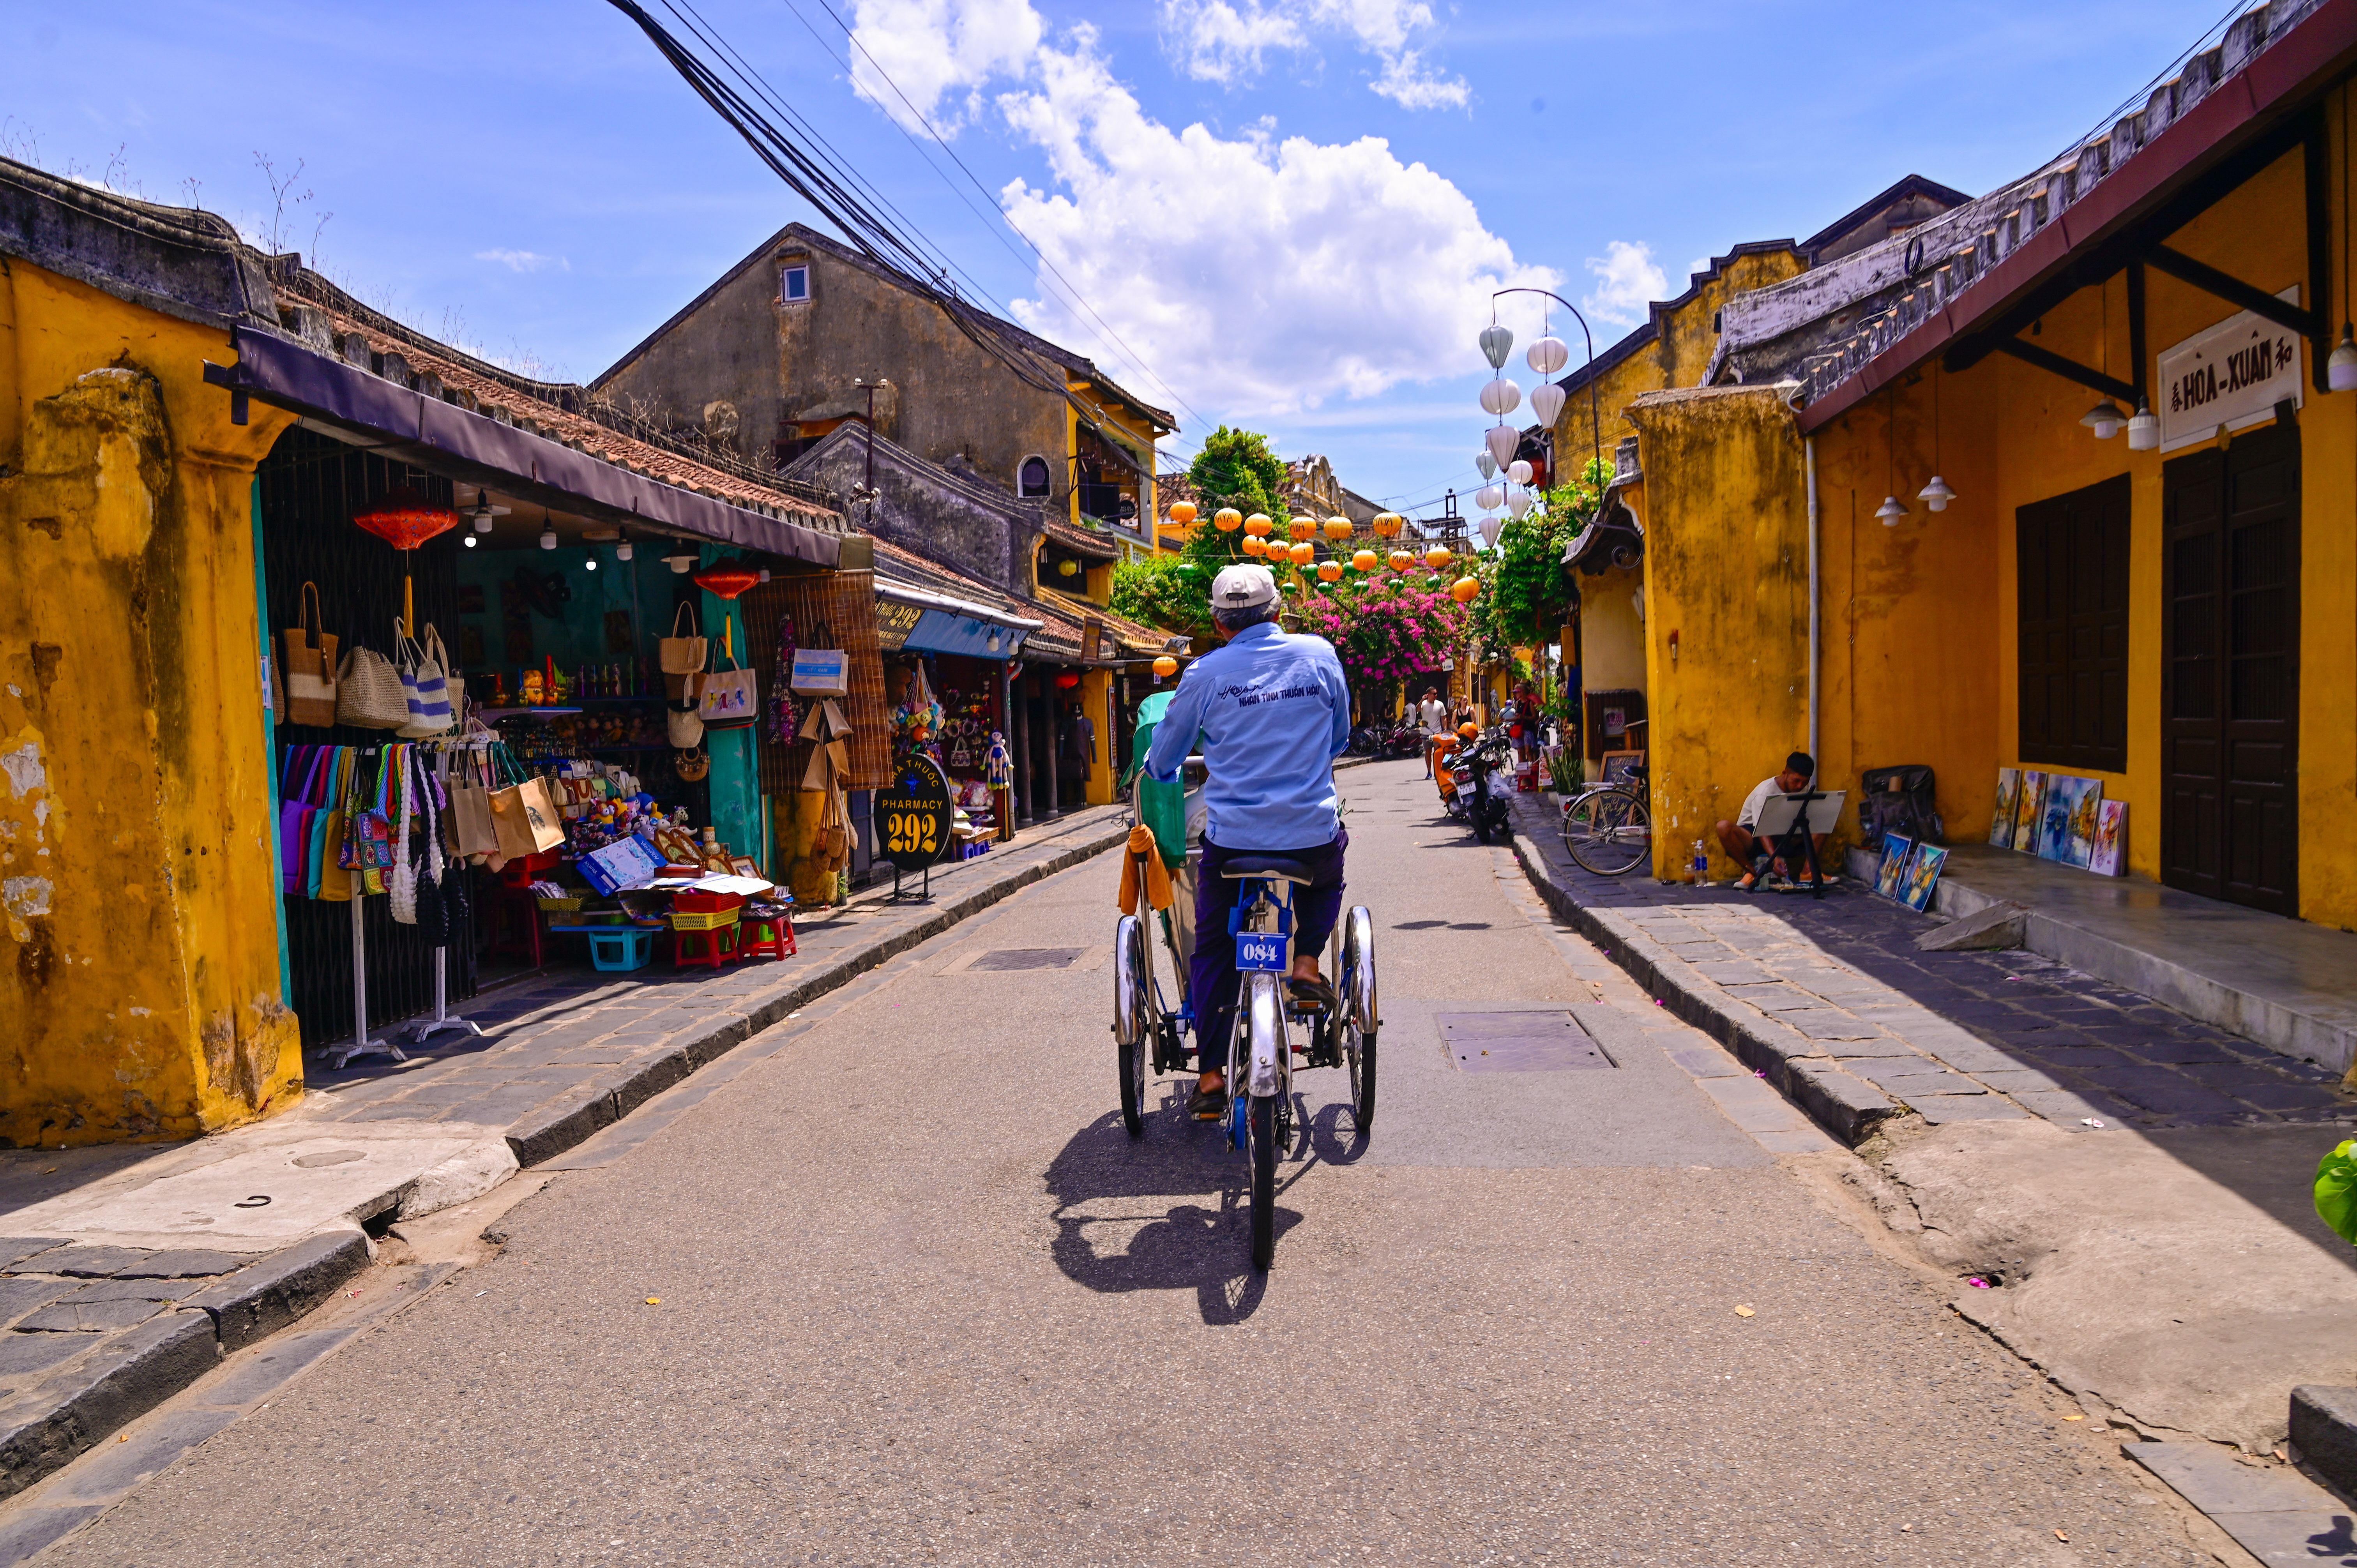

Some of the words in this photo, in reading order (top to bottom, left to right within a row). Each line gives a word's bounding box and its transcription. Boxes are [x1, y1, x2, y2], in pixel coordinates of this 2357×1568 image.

[2183, 330, 2272, 411] HÒA-XUÂN
[2275, 336, 2293, 371] 和
[1392, 555, 1412, 565] MAYA
[887, 606, 921, 630] 292
[1239, 694, 1260, 708] NHÂN
[892, 764, 905, 780] HÀ
[906, 759, 939, 788] THUỐC
[882, 800, 943, 810] PHARMACY
[888, 813, 937, 853] 292
[1243, 943, 1278, 962] 084
